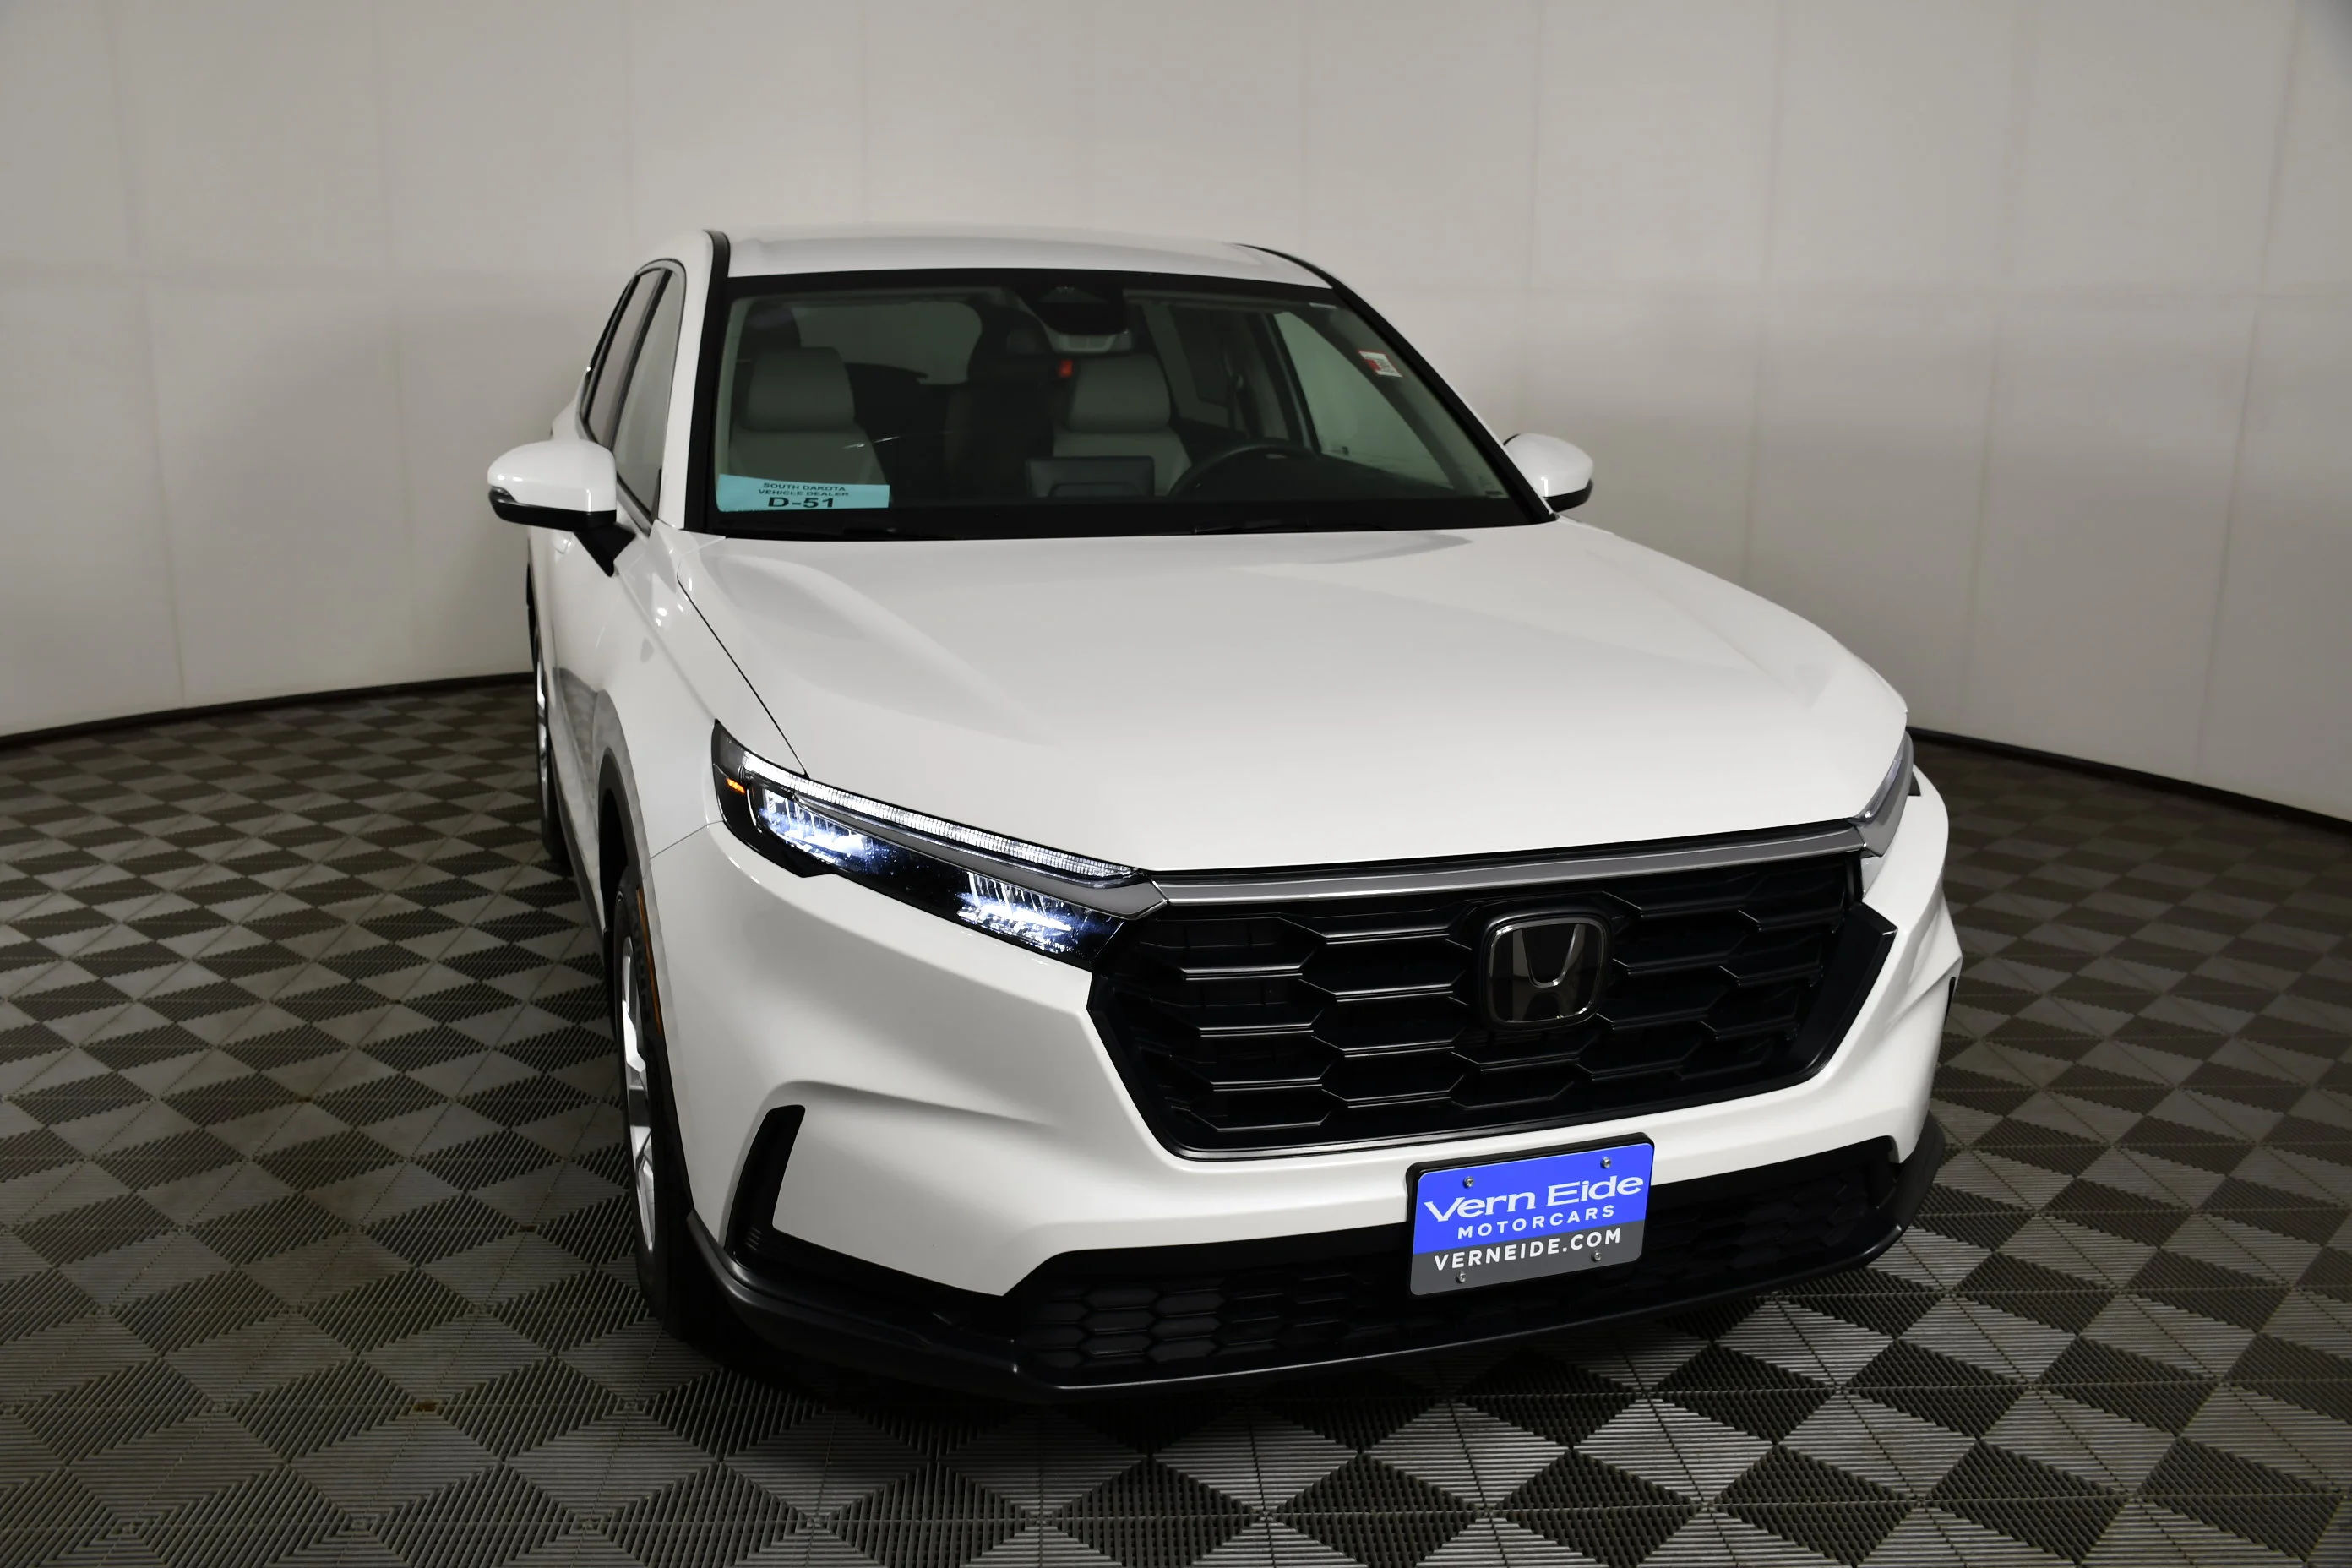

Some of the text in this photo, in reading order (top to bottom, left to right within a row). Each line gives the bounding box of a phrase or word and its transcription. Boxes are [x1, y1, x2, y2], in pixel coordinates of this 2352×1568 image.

[768, 497, 834, 508] D-51
[1424, 1175, 1644, 1222] Vern Eide
[1457, 1205, 1614, 1239] MOTORCARS
[1434, 1228, 1621, 1271] VERNEIDE.COM
